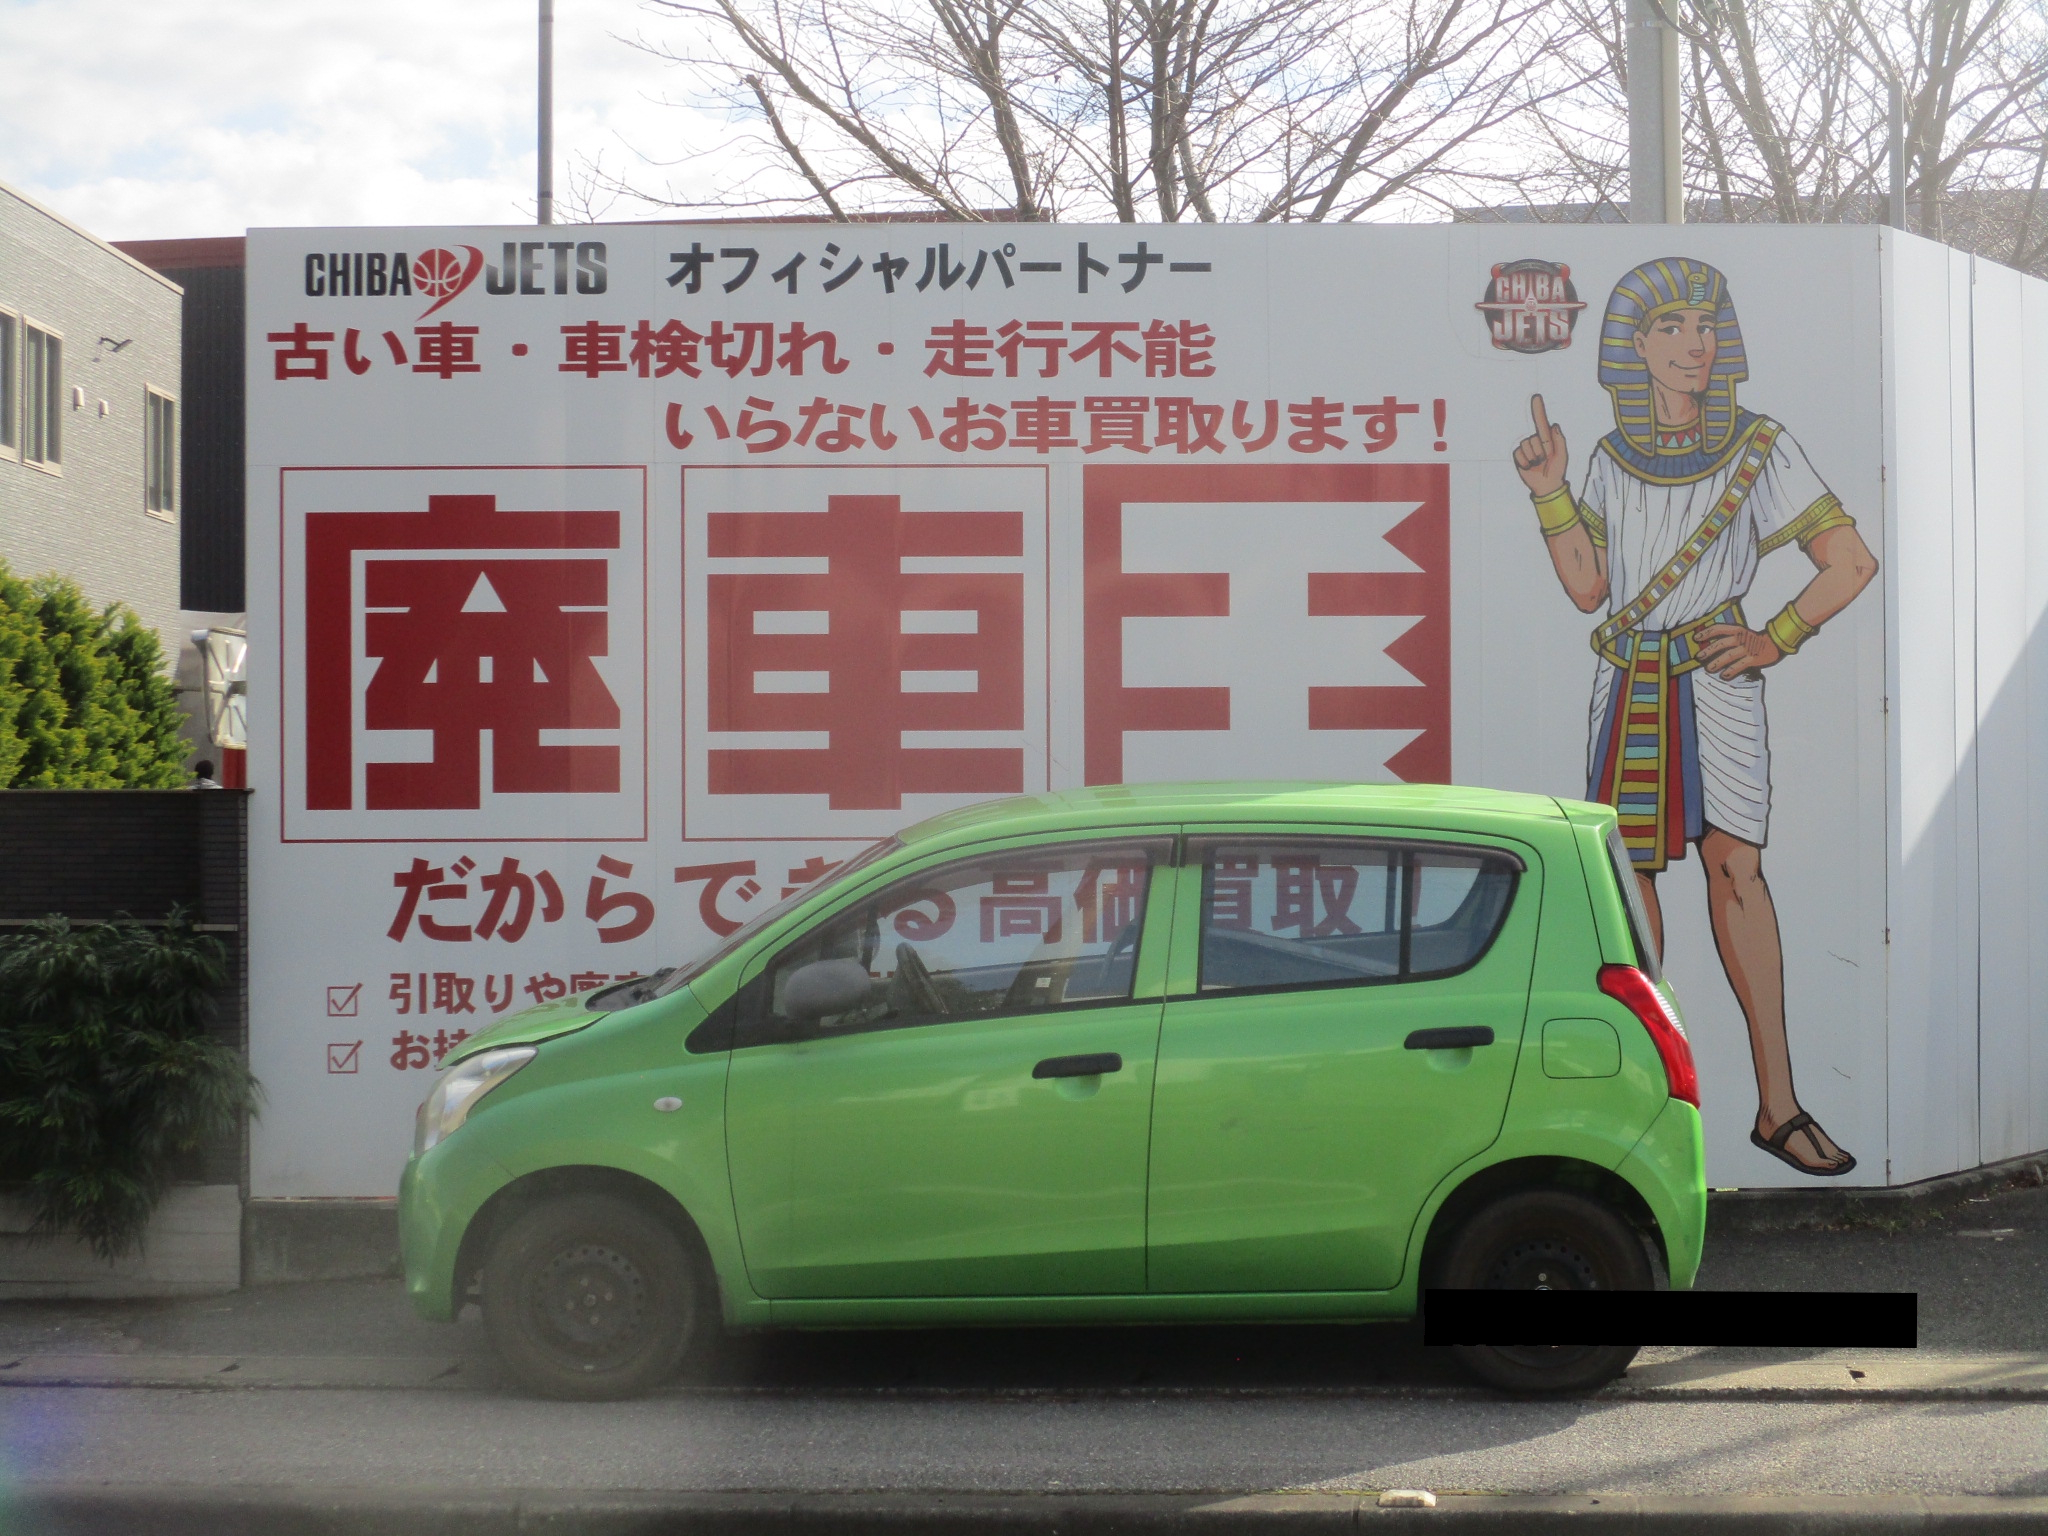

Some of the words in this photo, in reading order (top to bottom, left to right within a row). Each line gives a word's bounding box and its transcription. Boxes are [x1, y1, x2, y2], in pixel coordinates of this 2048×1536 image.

[305, 252, 411, 297] CHIBA
[485, 241, 608, 296] JETS
[666, 241, 1213, 296] オフィシャルパートナー
[1496, 272, 1567, 302] CHIBA
[267, 318, 1217, 380] 古い車・車検切れ・走行不能
[1493, 309, 1569, 343] JETS
[666, 396, 1448, 455] いらないお車買取ります!
